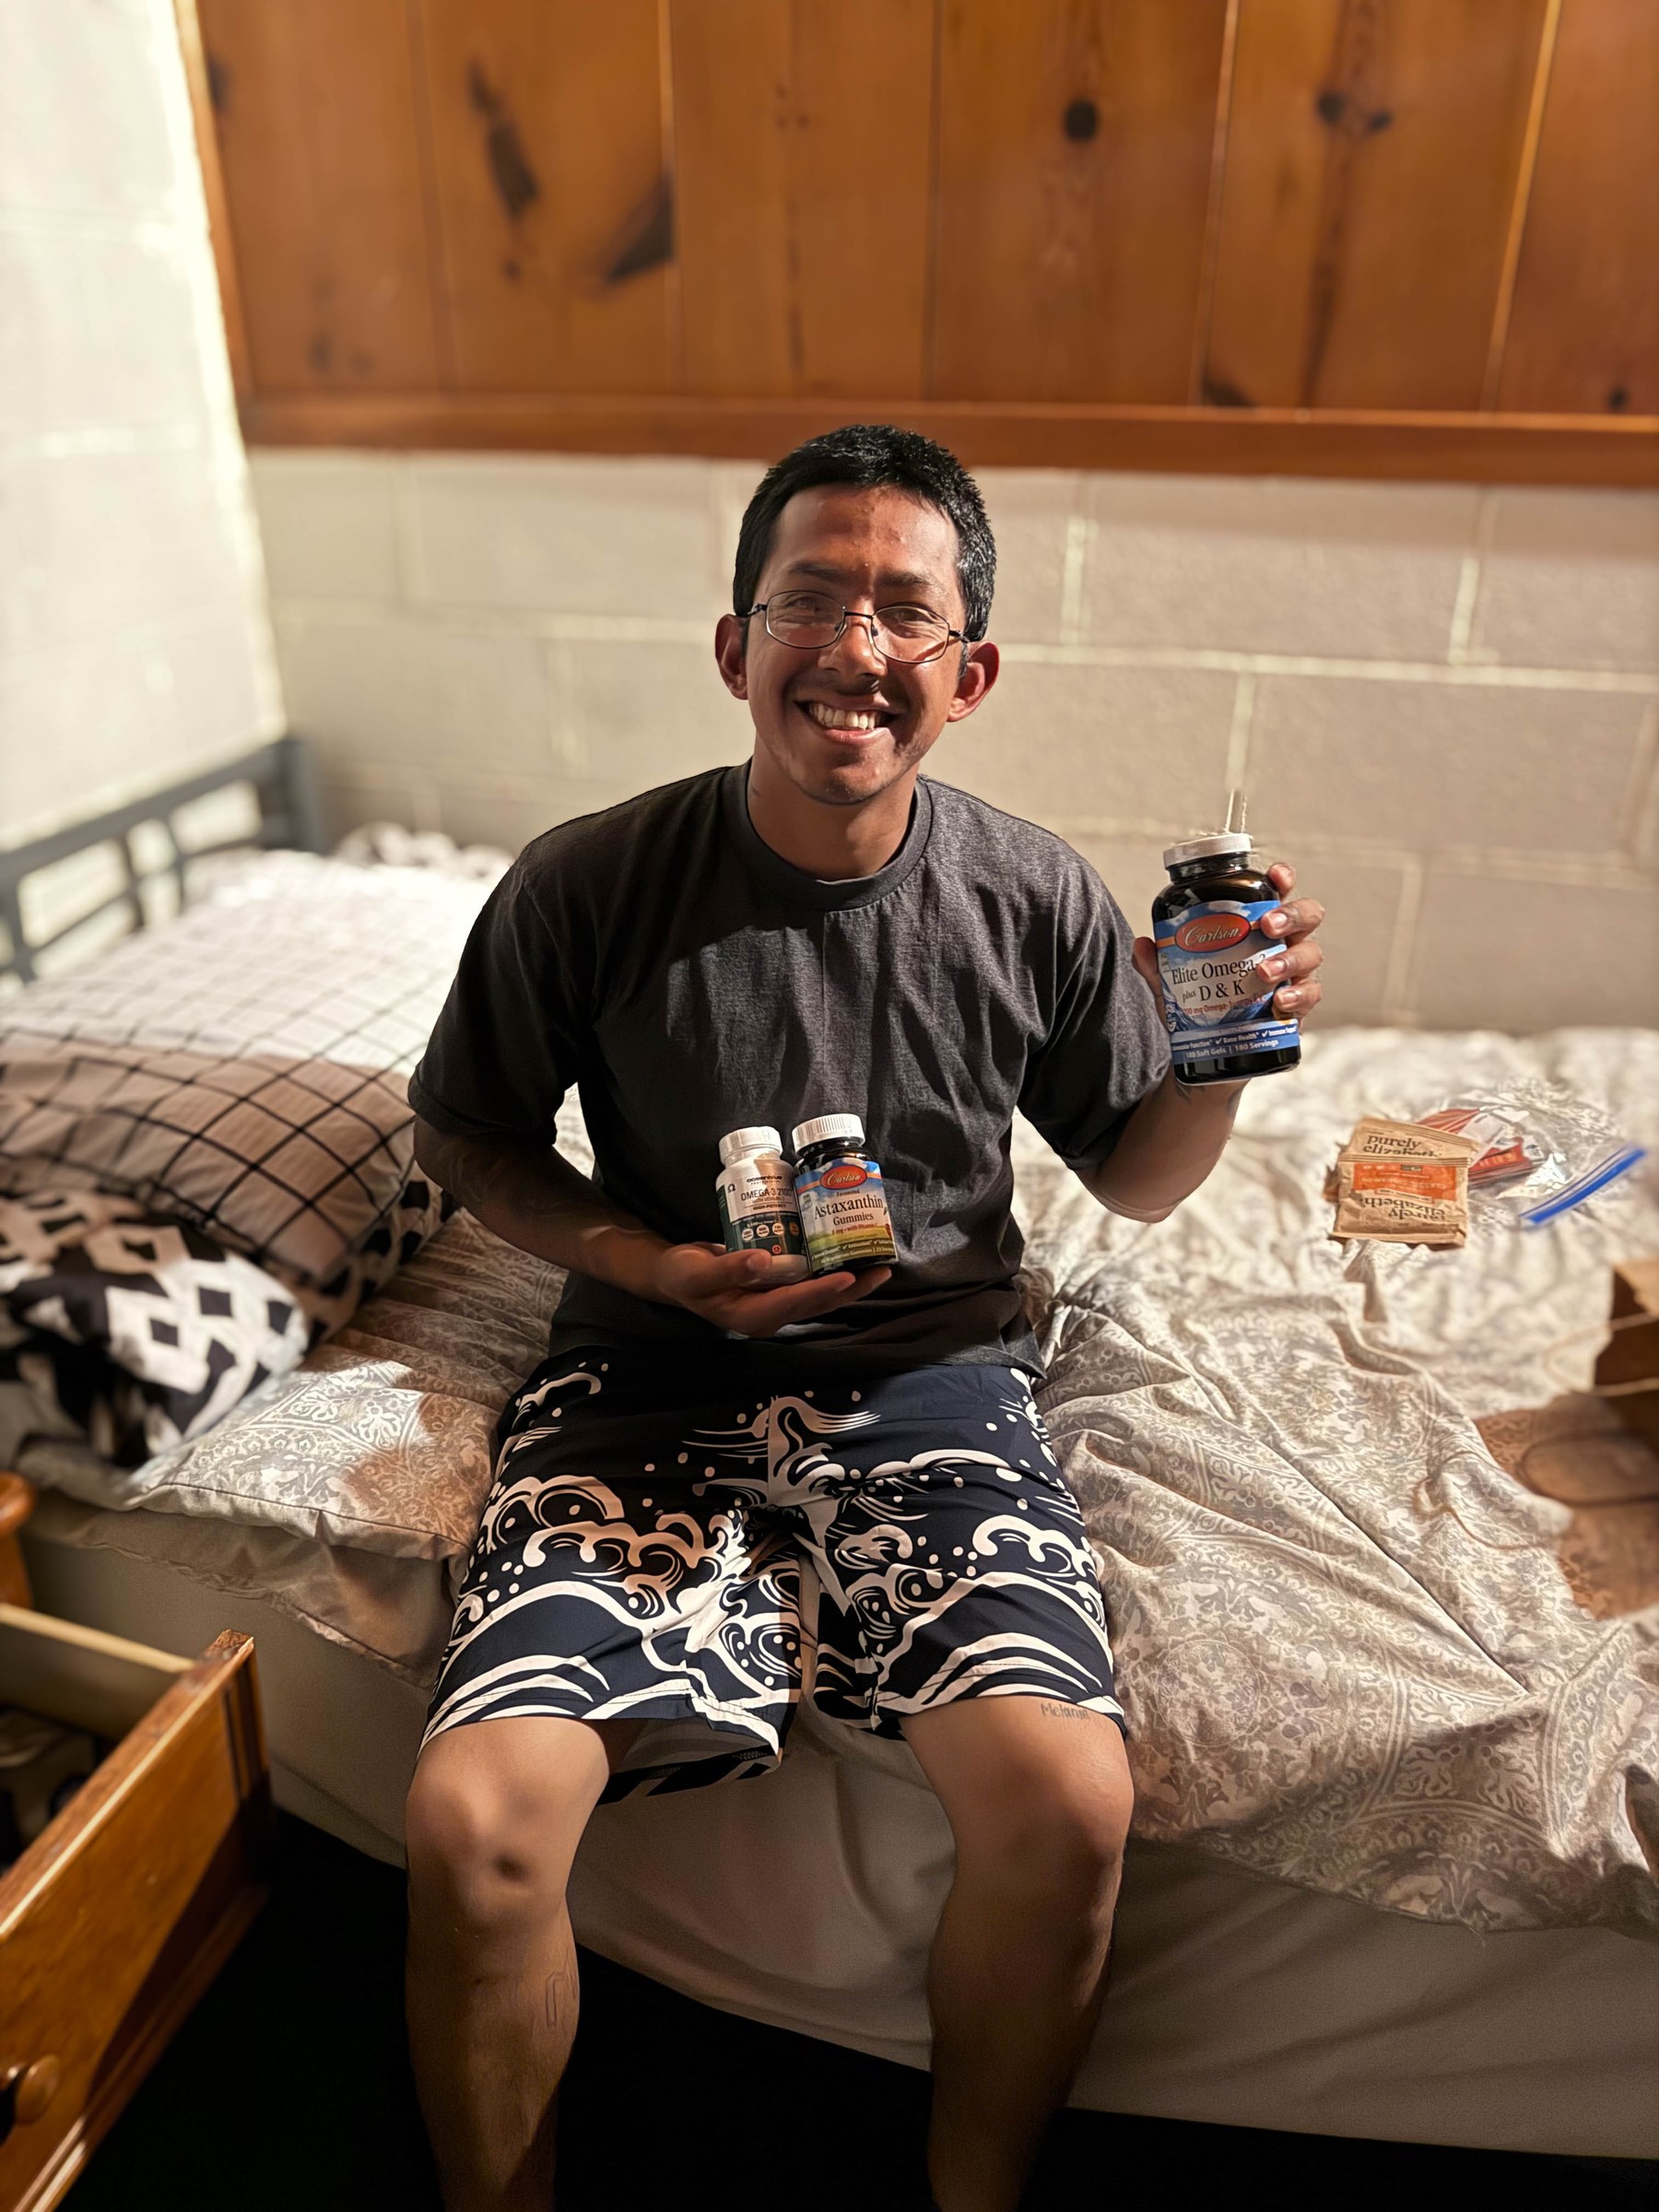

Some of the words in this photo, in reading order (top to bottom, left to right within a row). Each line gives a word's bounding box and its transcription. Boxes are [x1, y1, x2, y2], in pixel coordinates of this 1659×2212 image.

[1183, 924, 1240, 947] Carlson
[1171, 967, 1198, 985] Elite
[1182, 989, 1196, 1004] plus
[1198, 985, 1211, 1002] D
[1215, 982, 1230, 998] &
[1233, 979, 1245, 995] K
[1235, 1043, 1249, 1052] 180
[1249, 1039, 1279, 1049] Servings
[1367, 1135, 1420, 1152] purely
[827, 1171, 862, 1186] Carlson
[740, 1187, 777, 1201] OMEGA-3
[814, 1194, 885, 1219] Astaxanthin
[832, 1212, 875, 1227] Gummies
